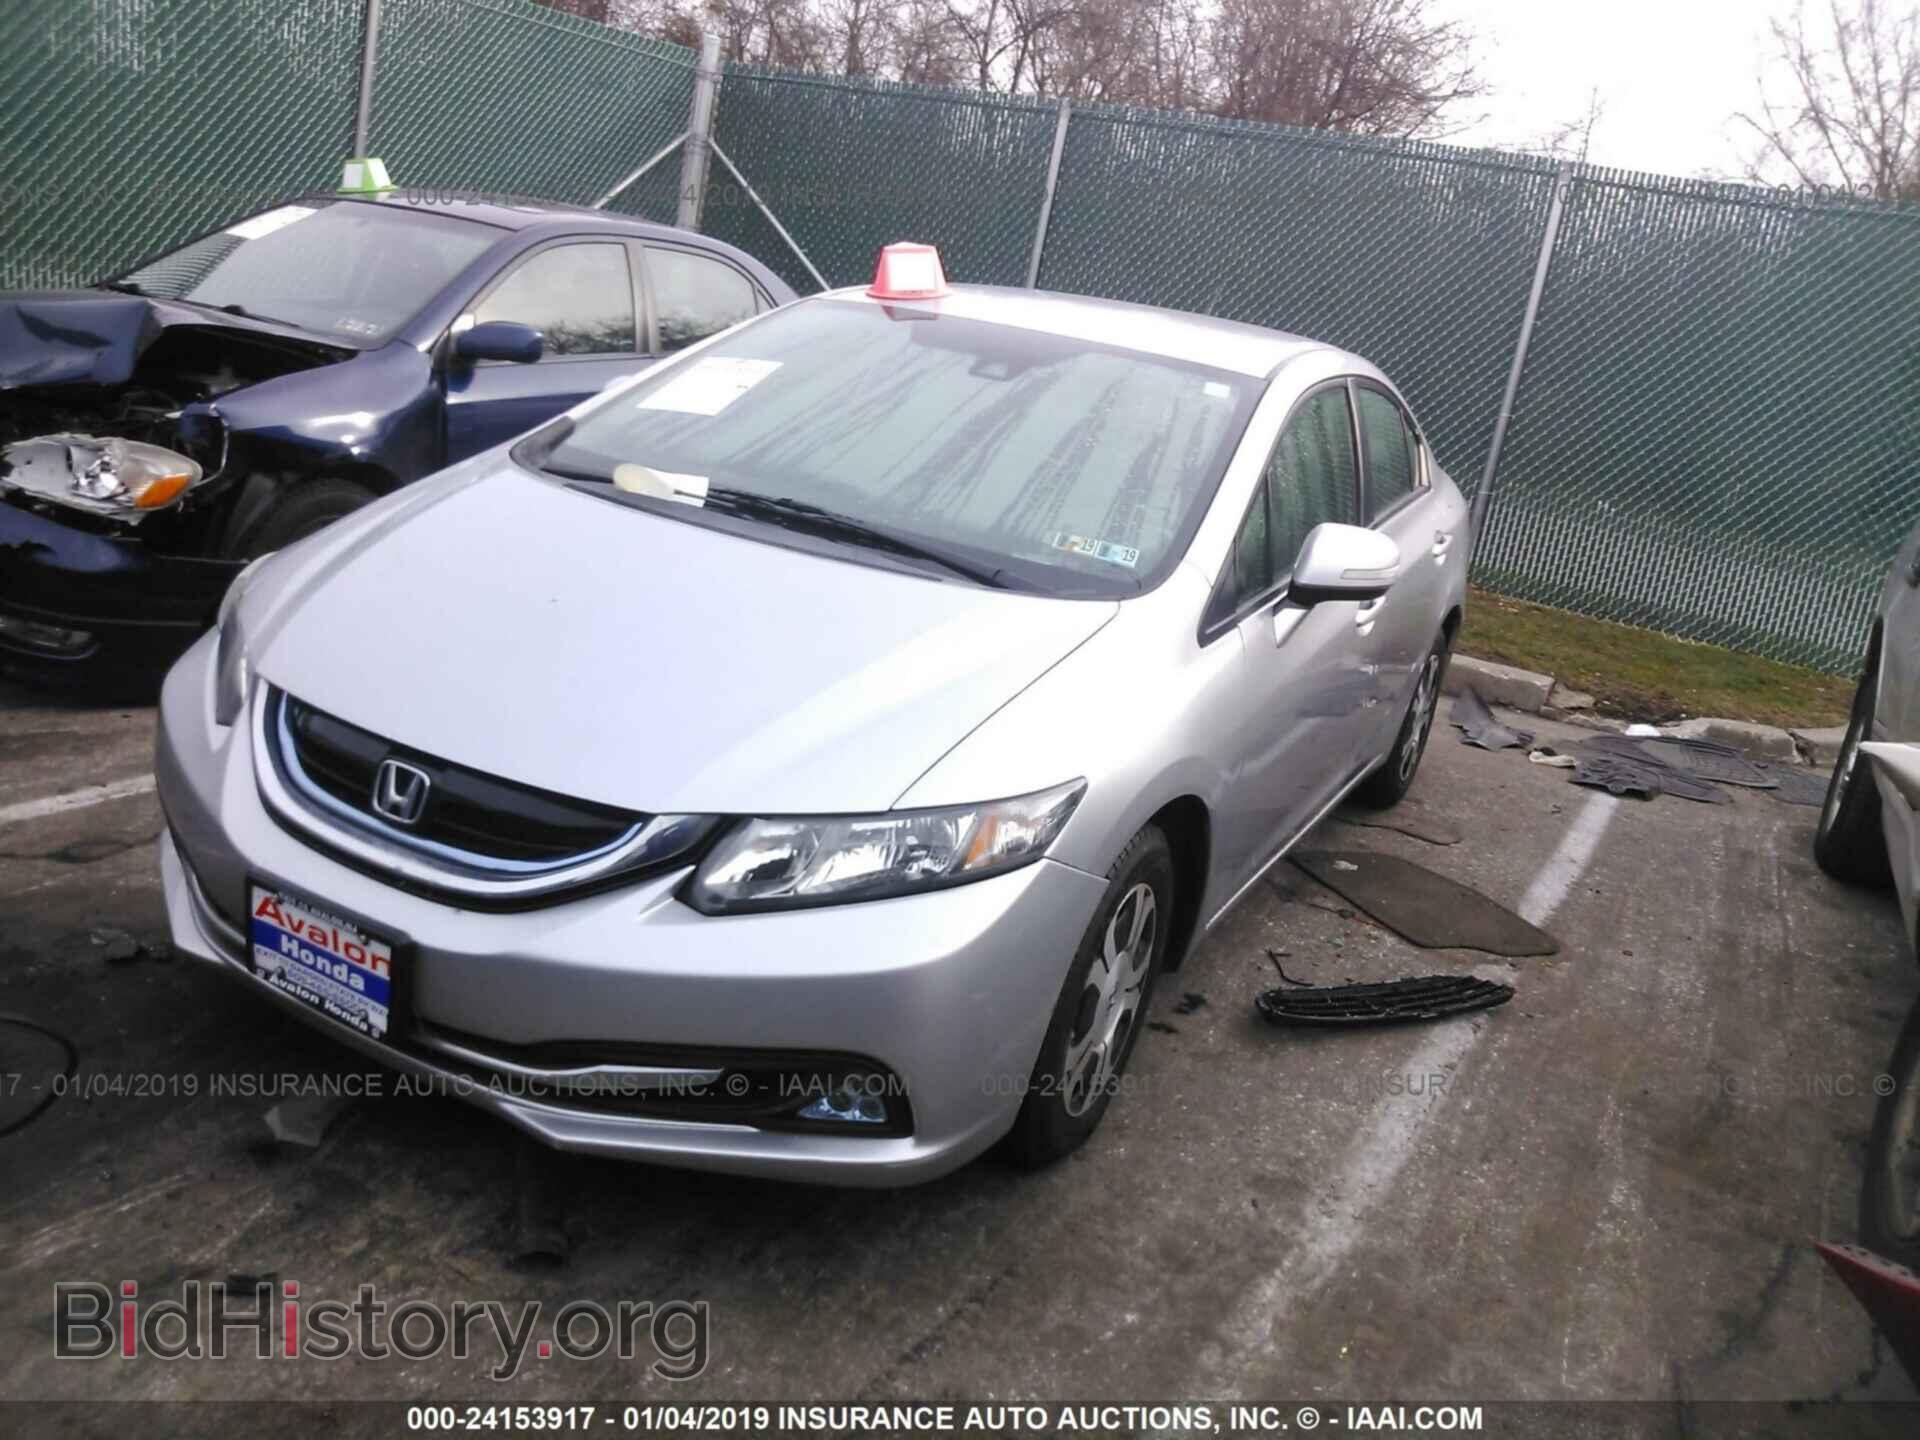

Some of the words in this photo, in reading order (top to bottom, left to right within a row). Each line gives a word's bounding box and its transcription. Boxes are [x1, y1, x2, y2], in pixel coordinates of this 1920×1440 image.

[1122, 549, 1136, 562] 19
[280, 934, 365, 991] Honda
[269, 974, 320, 1005] Avalon
[325, 1000, 368, 1032] Honda
